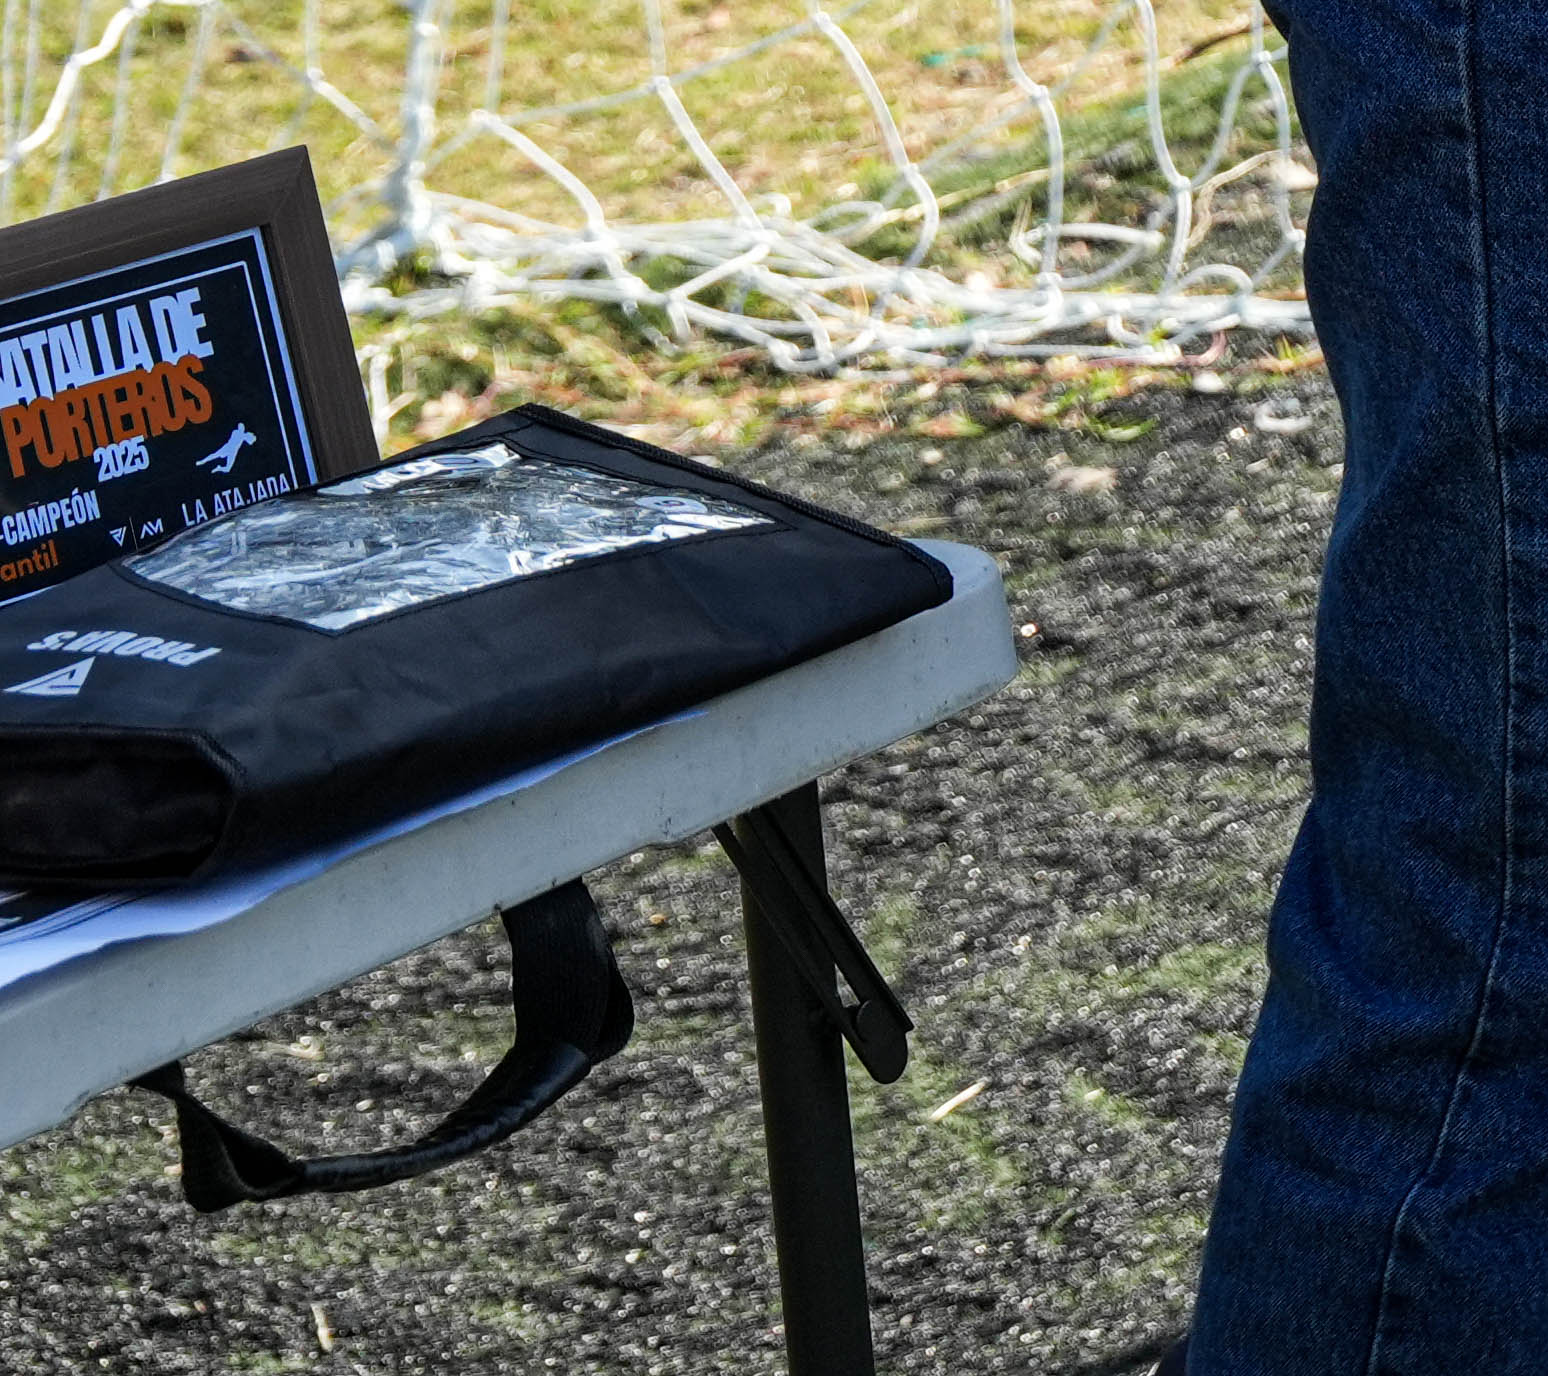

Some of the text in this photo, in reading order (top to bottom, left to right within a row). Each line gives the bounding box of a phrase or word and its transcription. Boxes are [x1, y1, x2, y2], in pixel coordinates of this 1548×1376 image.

[0, 286, 214, 409] ATALLA DE
[2, 354, 213, 479] PORTEROS
[93, 434, 150, 482] 2025
[181, 498, 208, 527] LA
